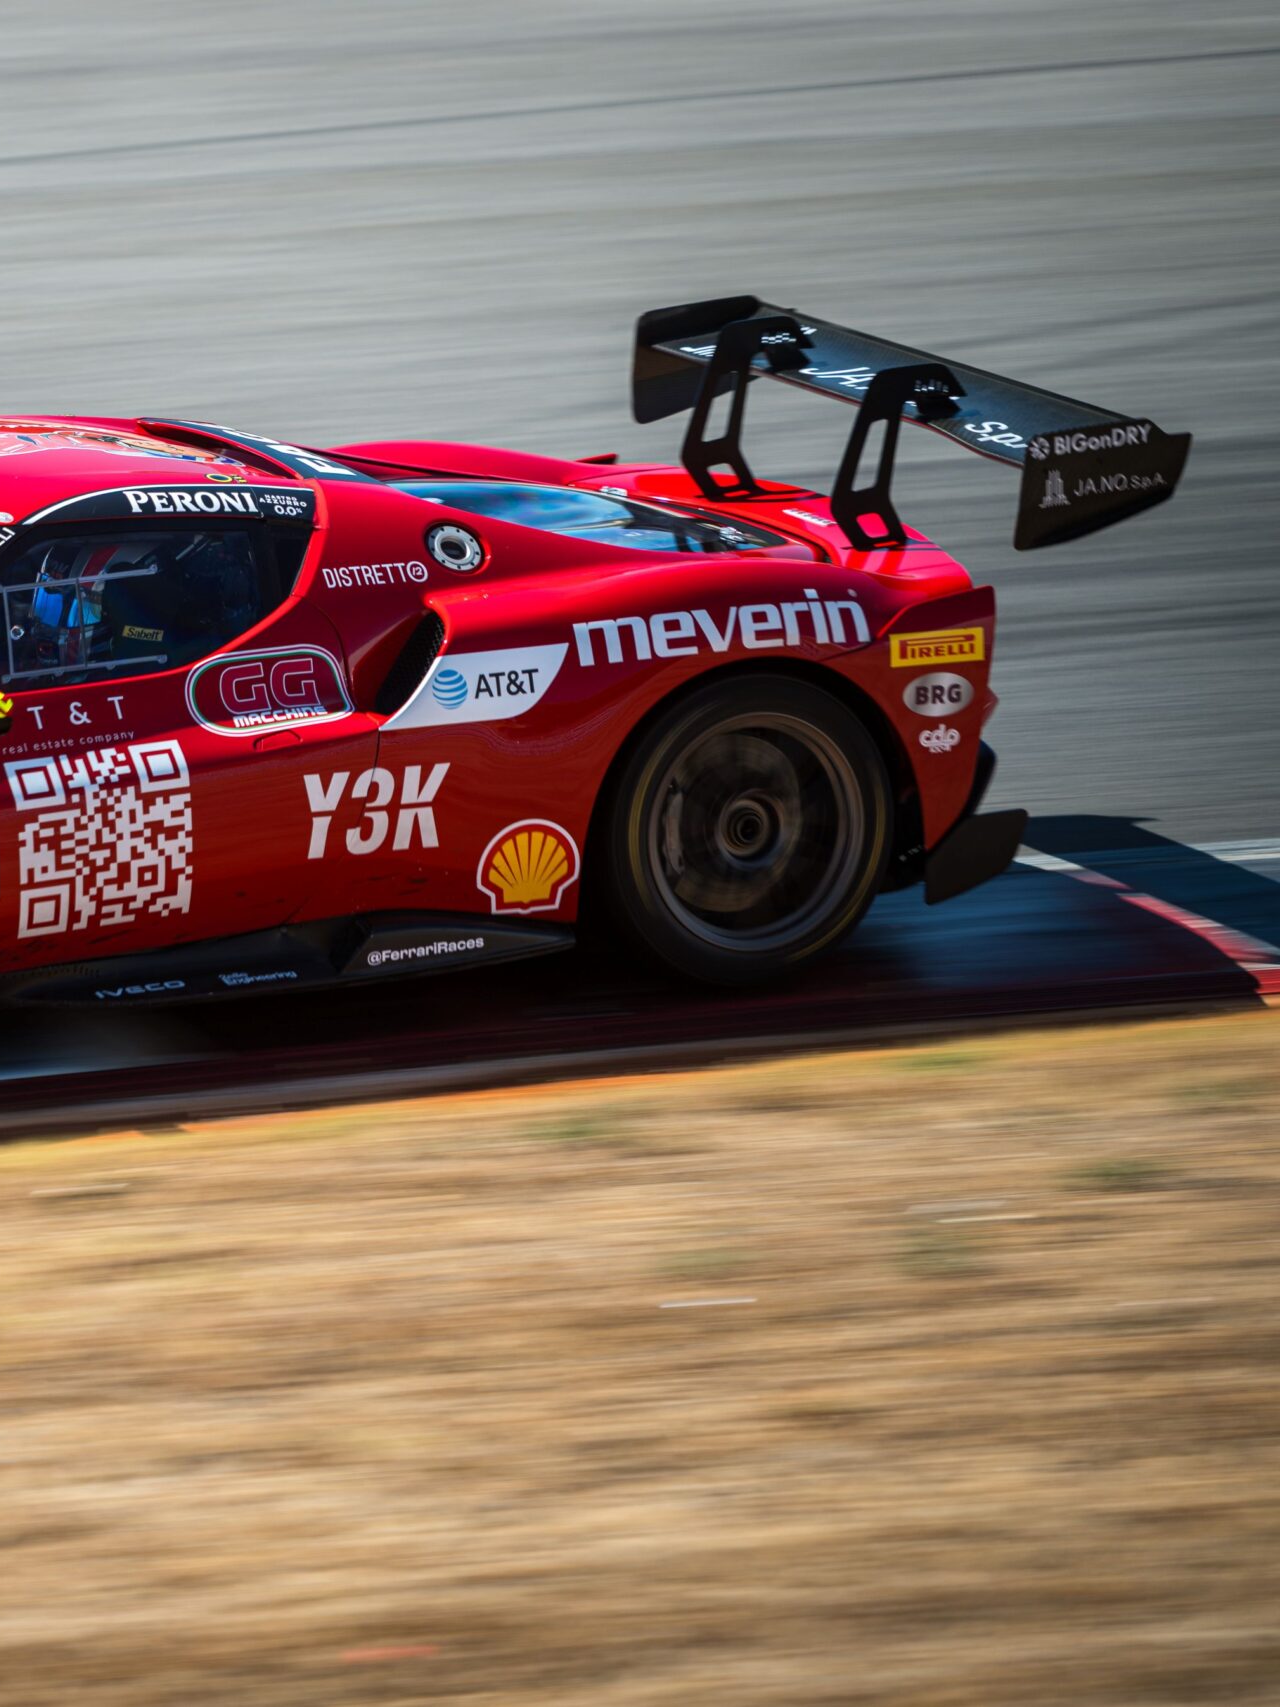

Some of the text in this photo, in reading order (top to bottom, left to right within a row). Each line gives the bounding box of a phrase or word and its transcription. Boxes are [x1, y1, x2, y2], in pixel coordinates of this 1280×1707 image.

[1054, 423, 1151, 455] BIGonDRY
[123, 491, 259, 513] PERONI
[259, 497, 308, 508] AZZURRO
[572, 588, 871, 667] meverin
[899, 633, 977, 660] PIRELLI
[220, 658, 322, 714] GG
[475, 668, 539, 698] AT&T
[914, 684, 962, 705] BRG
[27, 696, 124, 730] T & T
[233, 706, 328, 728] MACCHINE
[2, 729, 136, 756] real estate company
[303, 762, 451, 859] Y3K
[367, 936, 485, 966] @FerrariRaces
[95, 979, 186, 999] IVECO
